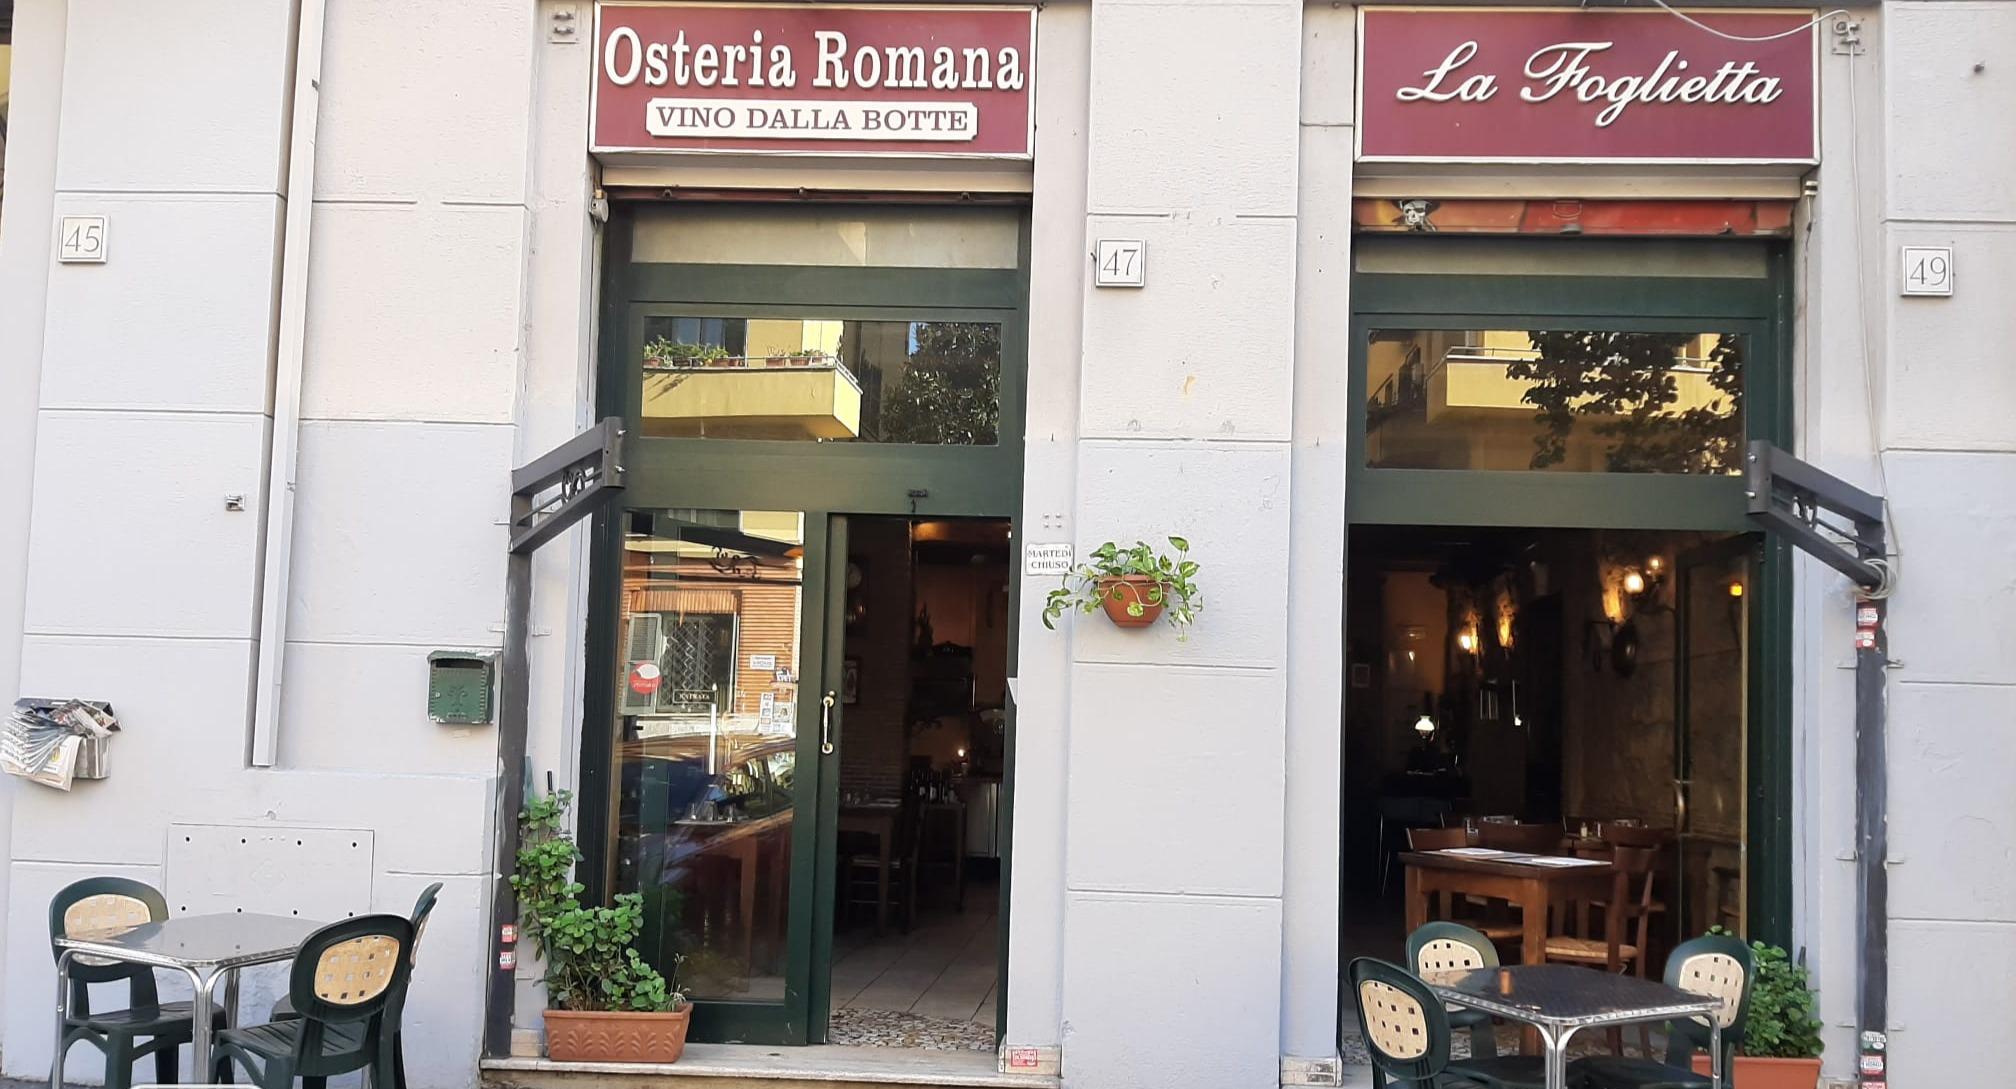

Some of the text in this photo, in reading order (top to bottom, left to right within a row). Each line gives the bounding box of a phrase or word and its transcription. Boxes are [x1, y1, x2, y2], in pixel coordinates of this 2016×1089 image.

[604, 26, 1024, 91] Osteria Romana
[1396, 40, 1783, 127] La Foglietta
[656, 106, 968, 131] VINO DALLA BOTTE
[64, 224, 100, 253] 45
[1103, 248, 1138, 276] 47
[1909, 256, 1947, 286] 49
[1031, 560, 1069, 569] CHIUSO
